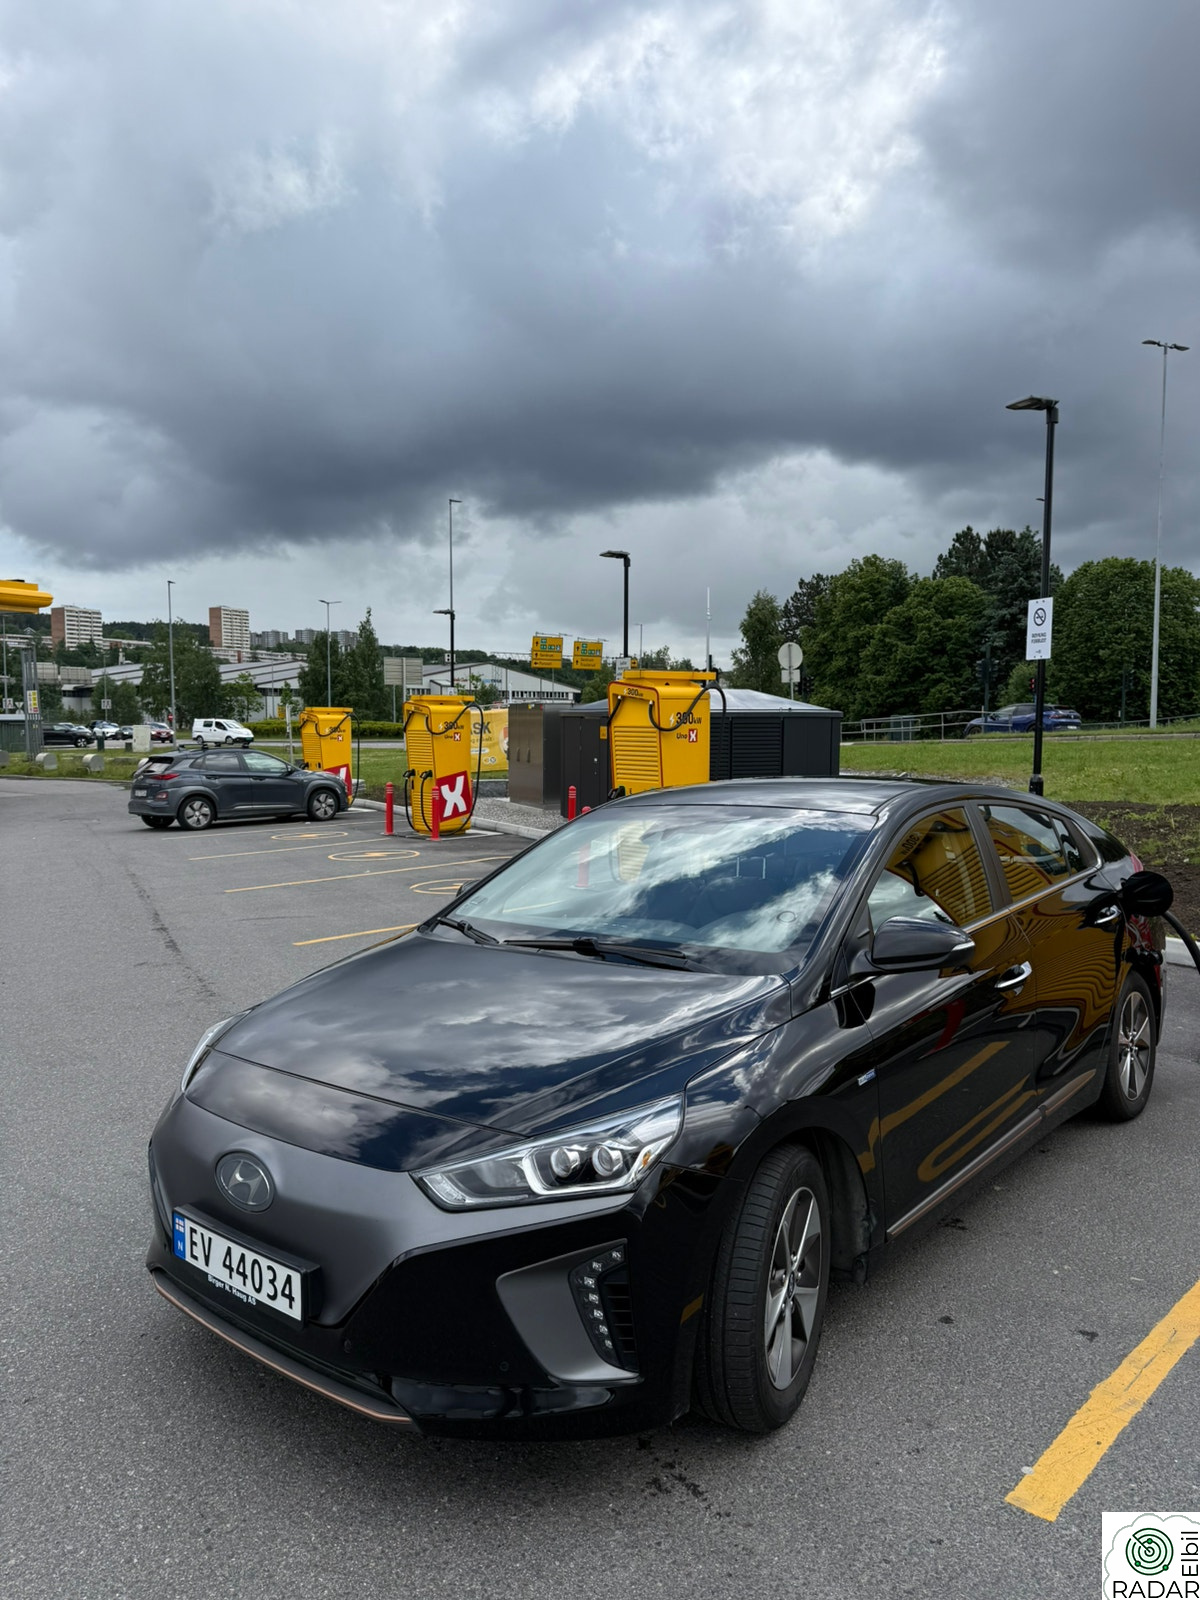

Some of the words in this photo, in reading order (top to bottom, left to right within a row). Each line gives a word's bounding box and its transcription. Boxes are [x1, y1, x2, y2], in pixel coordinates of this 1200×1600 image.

[440, 775, 467, 818] X
[177, 1240, 183, 1252] N
[190, 1226, 212, 1268] EV
[222, 1245, 295, 1310] 44034
